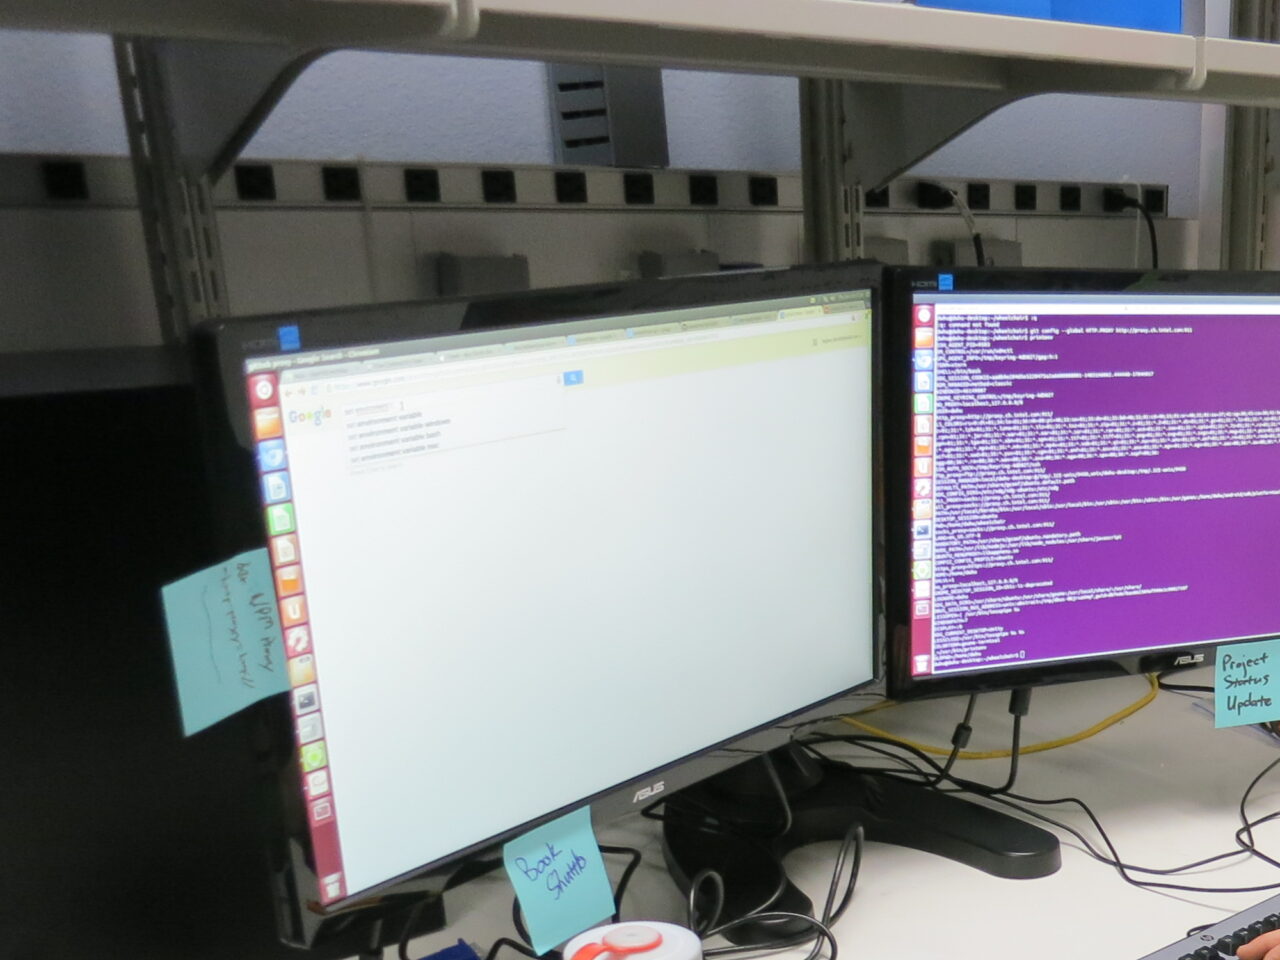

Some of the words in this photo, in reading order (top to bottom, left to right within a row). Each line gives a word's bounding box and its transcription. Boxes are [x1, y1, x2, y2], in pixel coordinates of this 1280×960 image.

[1174, 654, 1205, 665] ASUS
[1223, 652, 1269, 678] Project
[1223, 674, 1270, 689] Status
[1226, 692, 1272, 715] Update
[633, 781, 665, 803] ASUS
